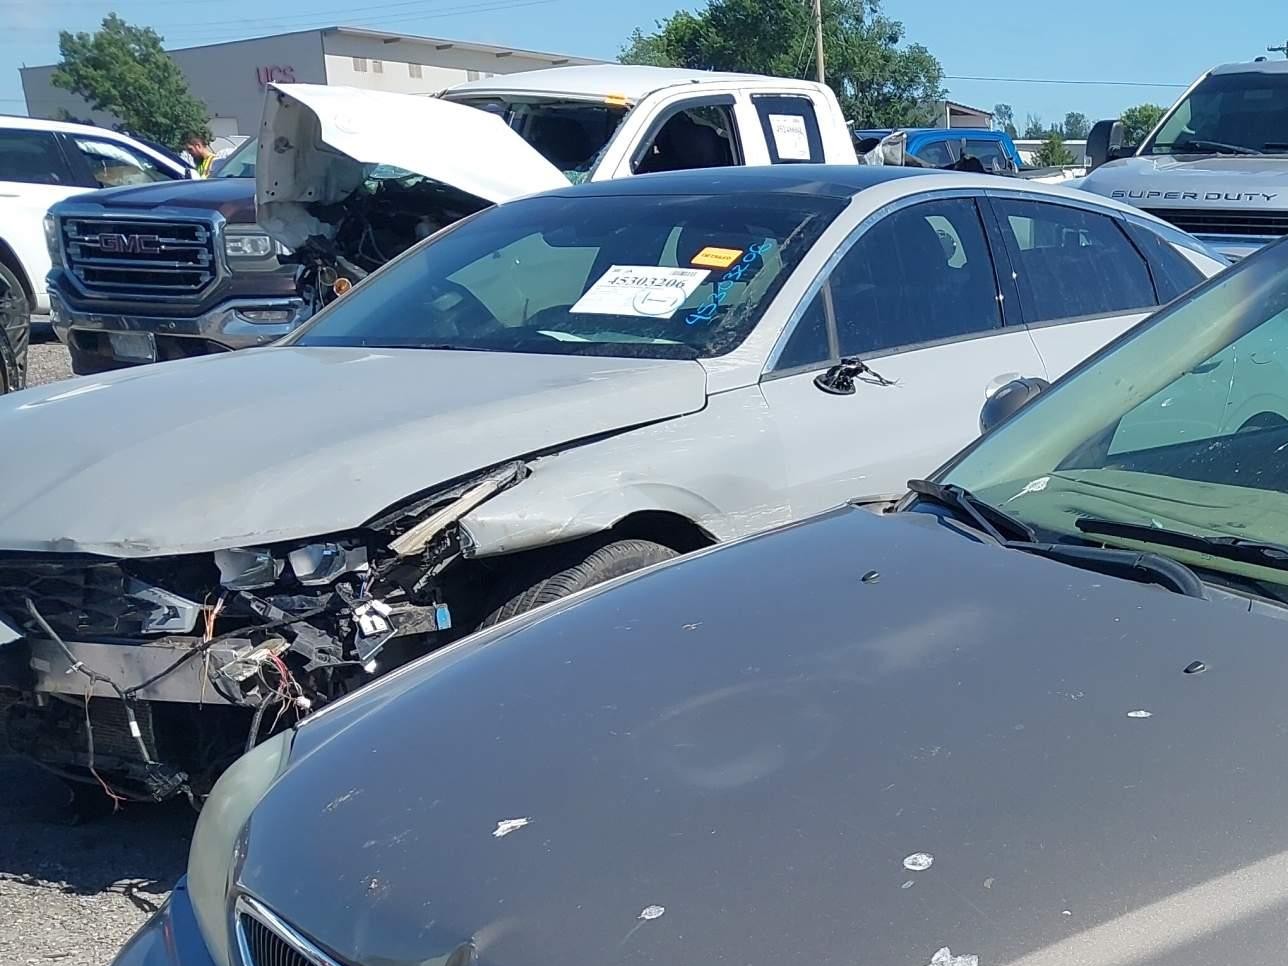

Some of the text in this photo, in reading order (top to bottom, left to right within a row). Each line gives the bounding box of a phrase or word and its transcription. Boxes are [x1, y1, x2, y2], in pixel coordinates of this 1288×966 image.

[1111, 190, 1278, 202] SUPER DUTY
[98, 233, 161, 254] GMC
[607, 275, 686, 290] 45303206
